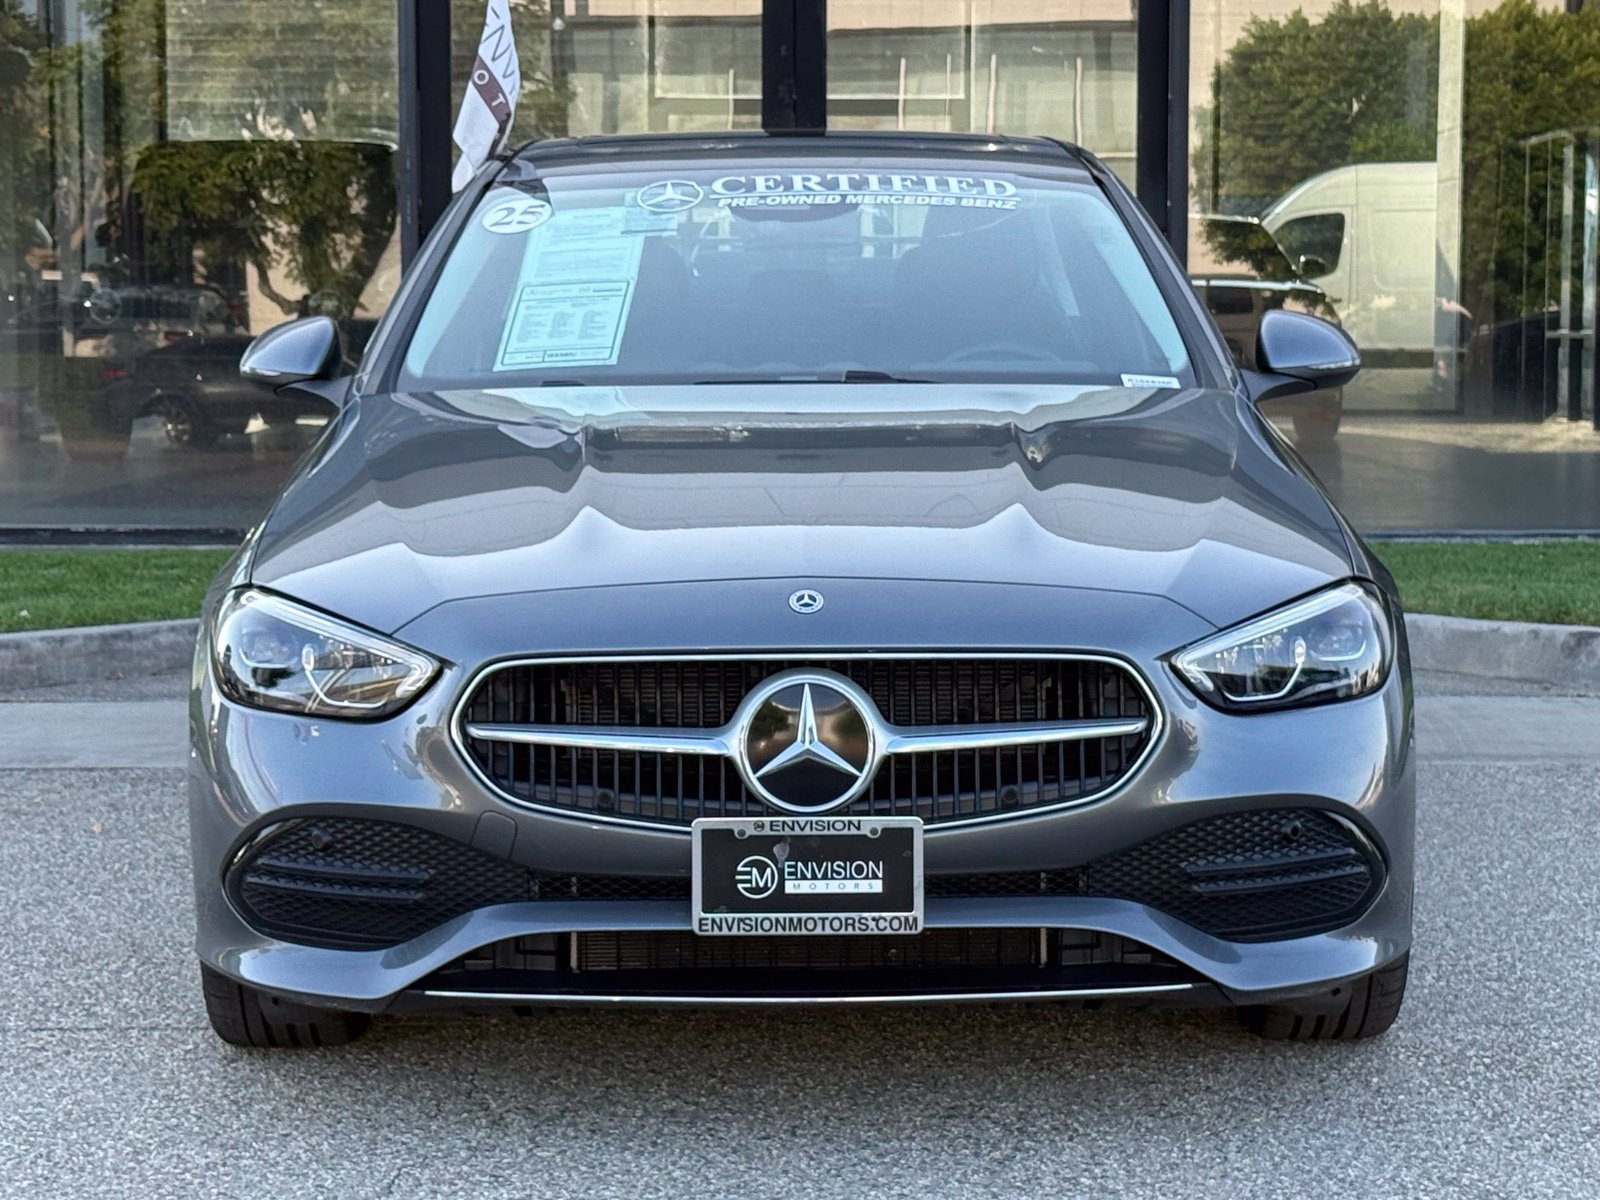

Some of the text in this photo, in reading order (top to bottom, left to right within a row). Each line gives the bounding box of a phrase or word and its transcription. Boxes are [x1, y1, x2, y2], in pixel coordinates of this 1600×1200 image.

[711, 174, 1018, 195] CERTIFIED
[718, 194, 1017, 209] PRE-OWNED MERCEDES BENZ
[489, 203, 547, 228] 25
[769, 819, 861, 833] ENVISION
[784, 860, 883, 880] ENVISION
[792, 881, 874, 891] MOTORS
[698, 915, 918, 933] ENVISIONMOTORS.COM
